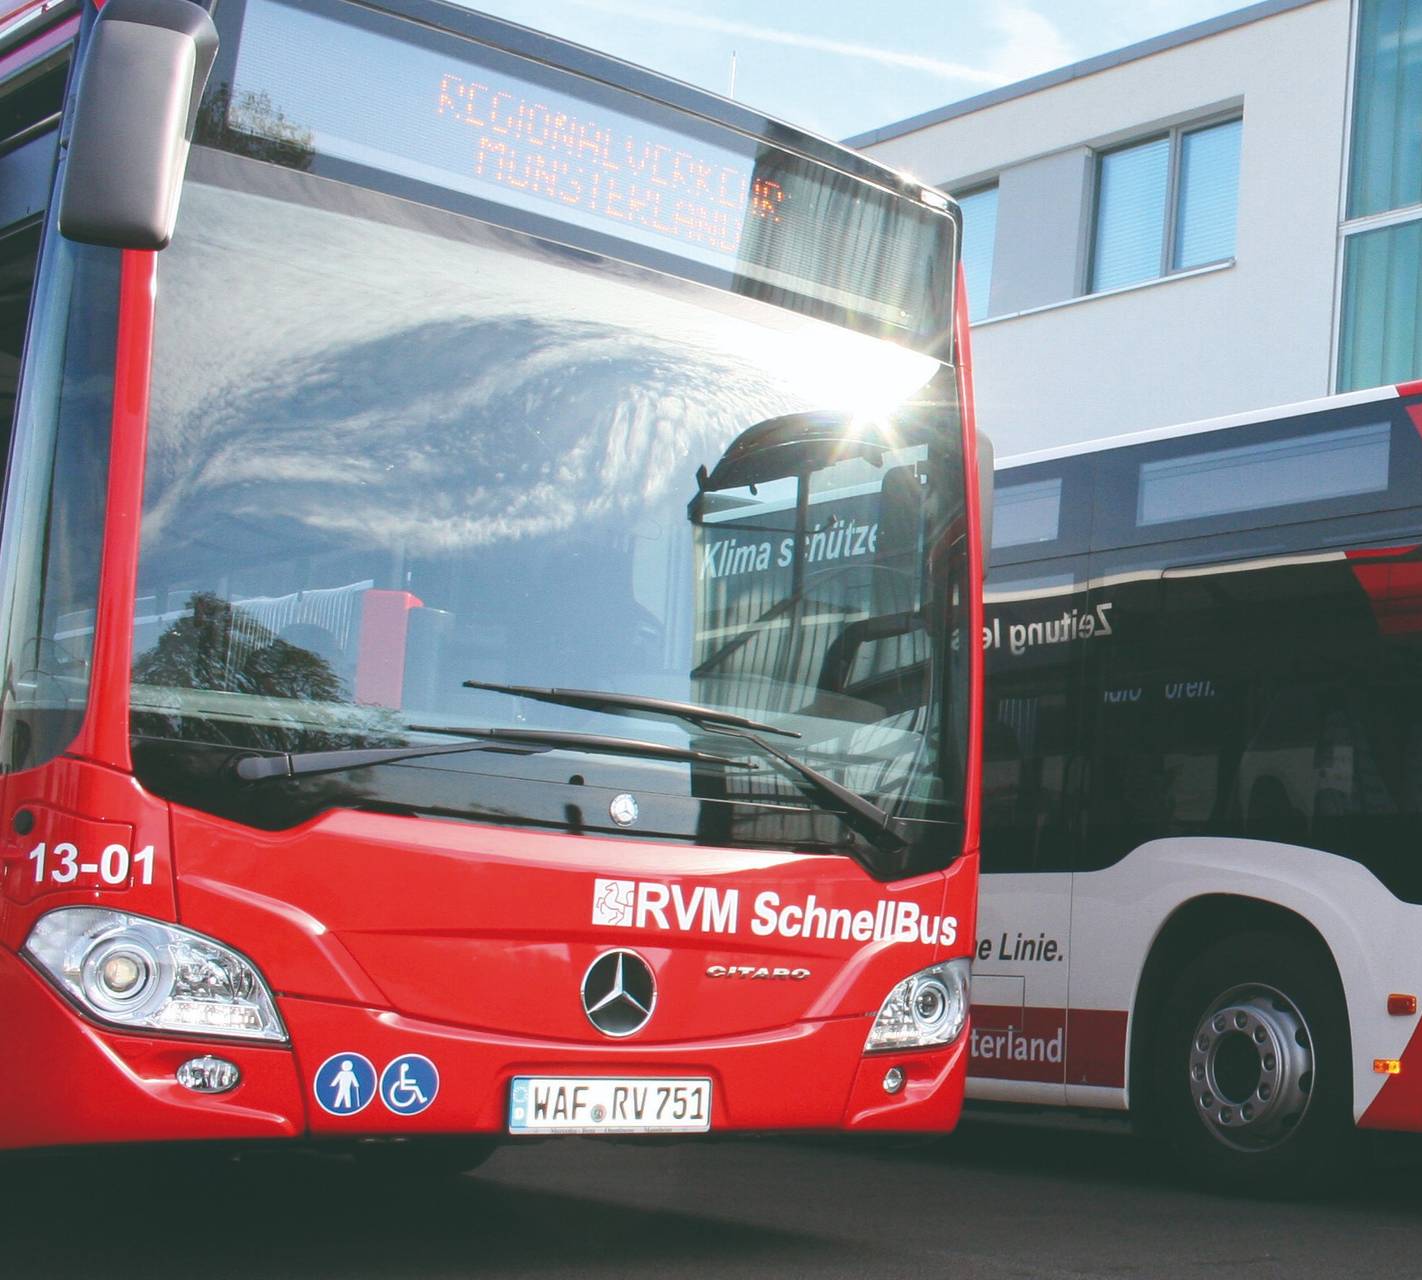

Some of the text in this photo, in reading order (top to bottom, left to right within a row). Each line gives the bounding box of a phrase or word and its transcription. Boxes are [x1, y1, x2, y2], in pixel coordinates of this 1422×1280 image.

[701, 538, 771, 580] Klima
[28, 843, 155, 885] 13-01
[635, 881, 958, 946] RVM SchnellBus
[998, 932, 1064, 962] Linie.
[706, 965, 811, 980] CITARO
[534, 1086, 704, 1120] WAF RV 751
